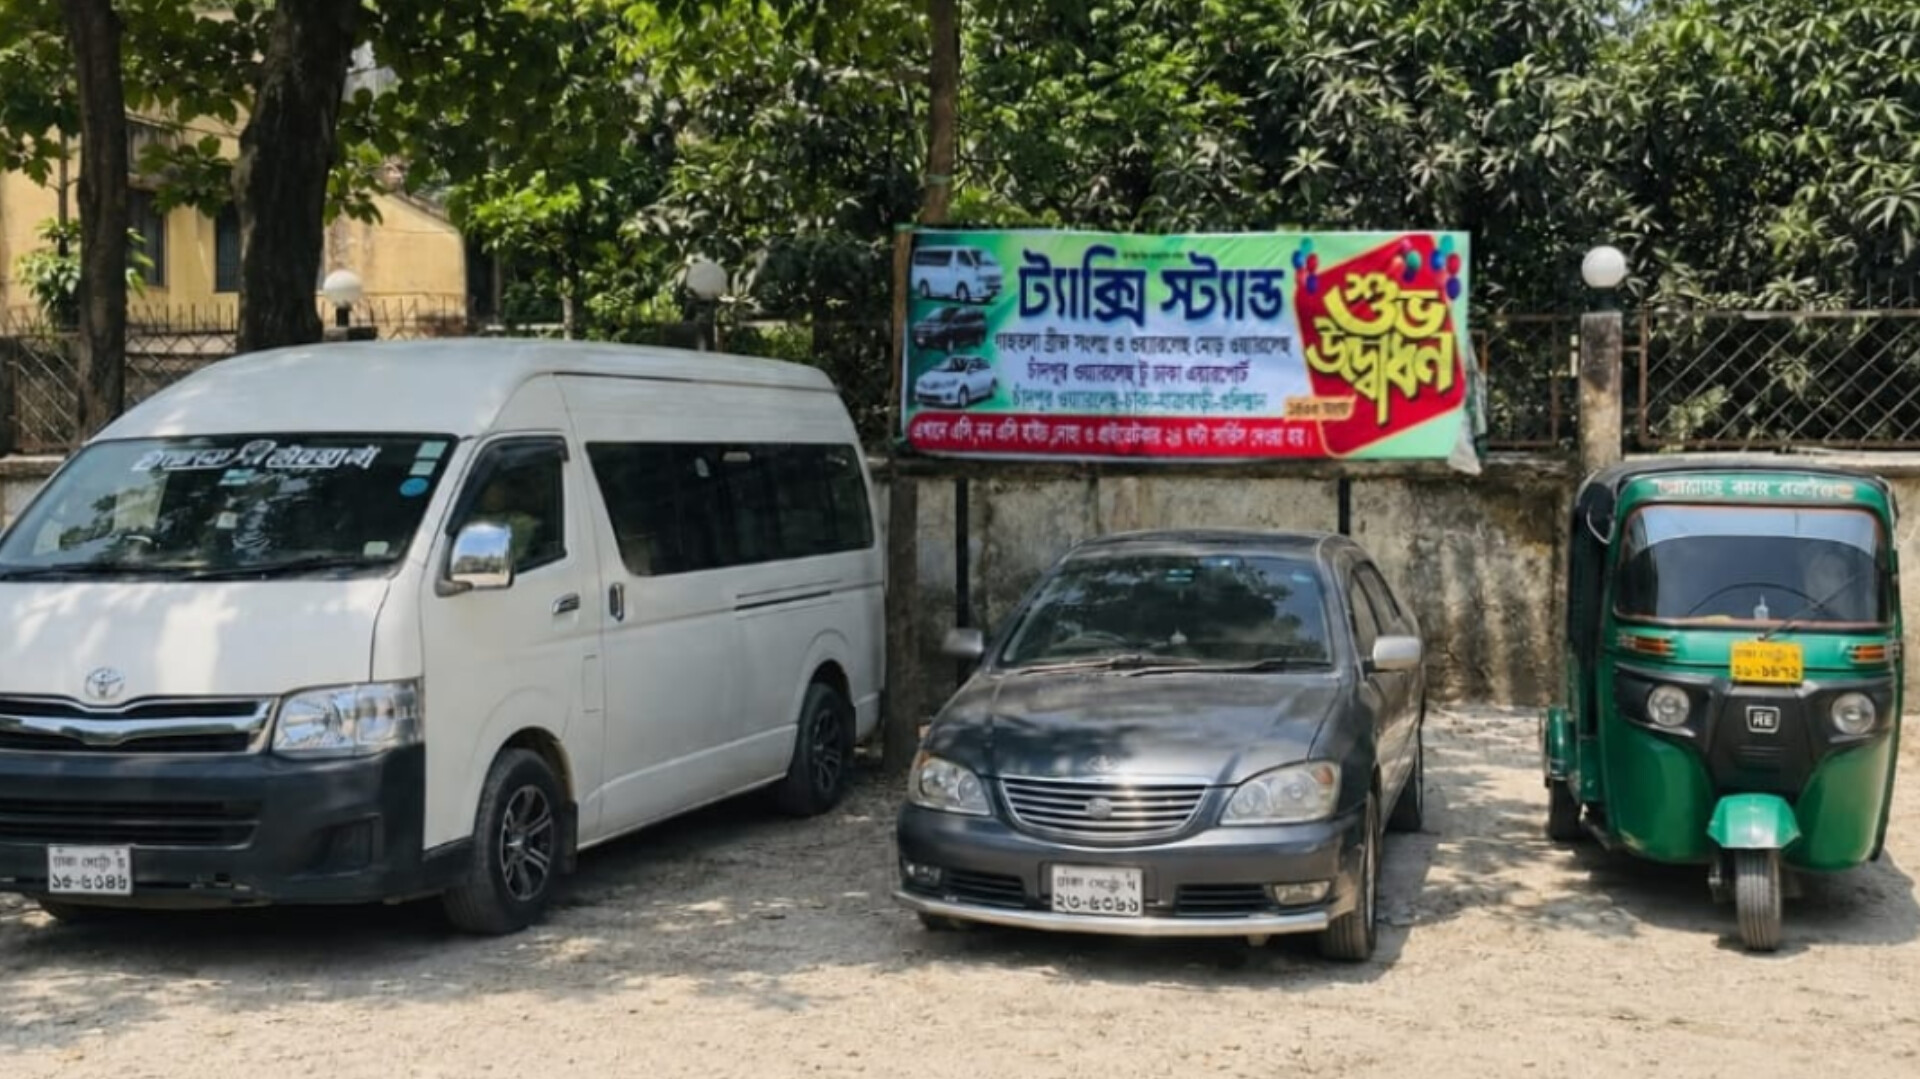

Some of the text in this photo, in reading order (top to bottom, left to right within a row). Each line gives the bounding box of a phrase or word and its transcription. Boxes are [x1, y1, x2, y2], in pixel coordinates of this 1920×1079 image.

[1018, 244, 1284, 327] ট্যাক্সি স্ট্যান্ড
[1323, 272, 1447, 338] শুভ
[1306, 316, 1454, 426] উদ্বোধন
